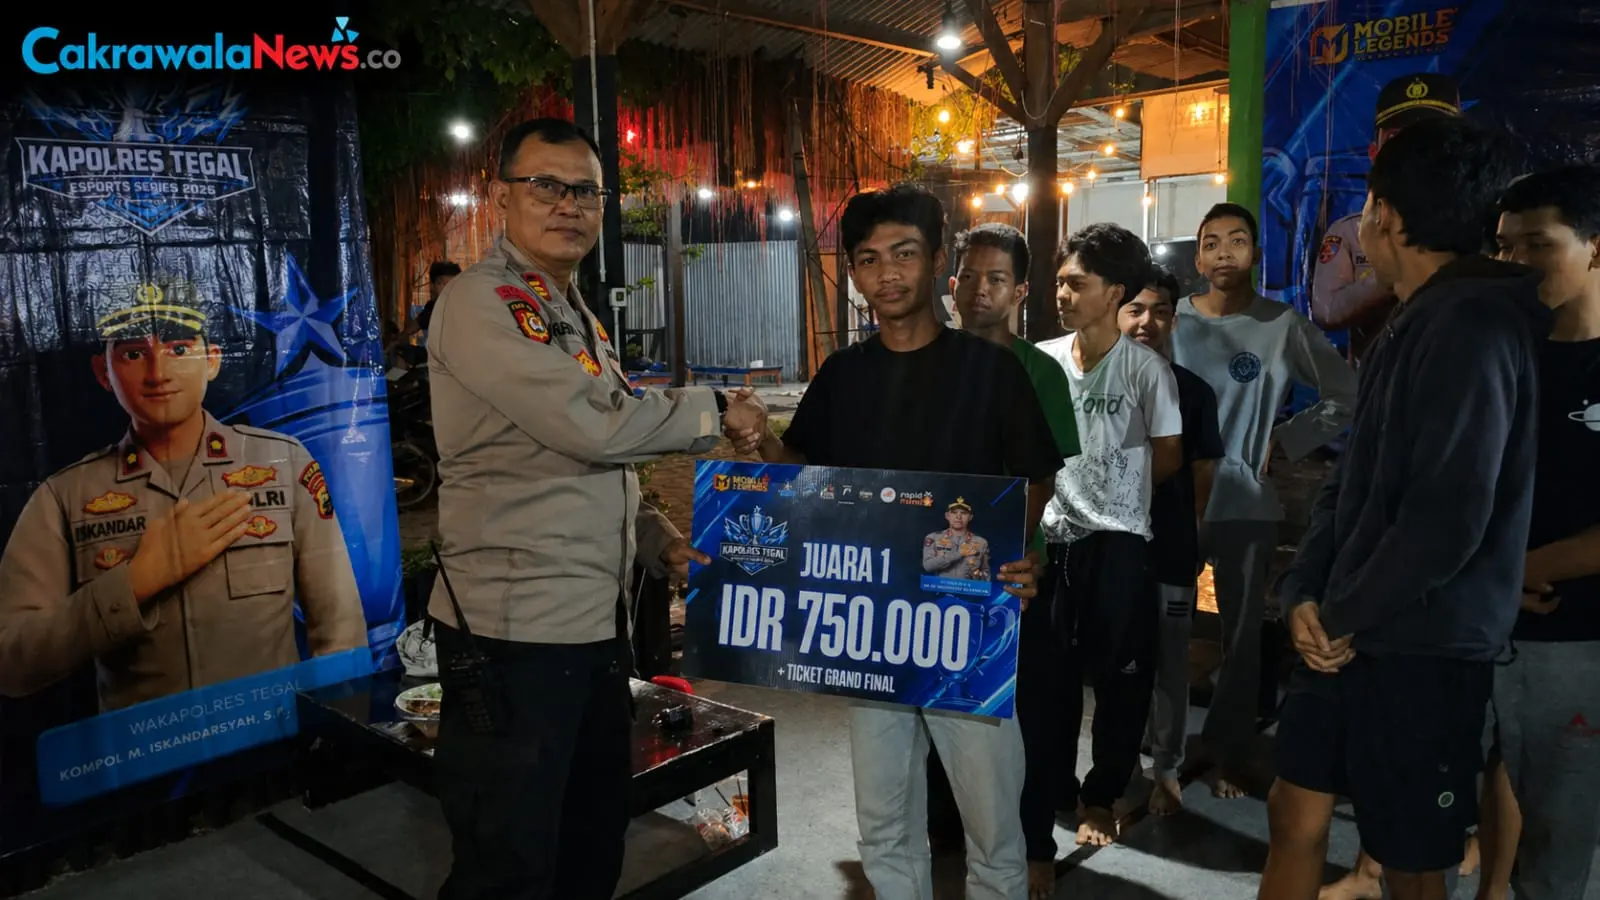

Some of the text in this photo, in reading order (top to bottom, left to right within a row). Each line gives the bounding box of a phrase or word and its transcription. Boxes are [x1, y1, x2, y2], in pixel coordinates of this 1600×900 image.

[1354, 8, 1458, 40] MOBILE
[1353, 28, 1449, 54] LEGENDS
[28, 146, 249, 182] KAPOLRES TEGAL
[70, 181, 130, 193] ESPORTS
[134, 181, 178, 193] SERIES
[248, 490, 286, 507] LRI
[76, 516, 147, 542] ISKANDAR
[800, 542, 890, 584] JUARA 1
[718, 583, 971, 672] IDR 750.000
[787, 663, 824, 684] TICKET
[824, 668, 862, 689] GRAND
[864, 673, 896, 693] FINAL
[129, 680, 303, 735] WAKAPOLRES TEGAL
[60, 754, 123, 781] KOMPOL
[128, 747, 145, 760] M.
